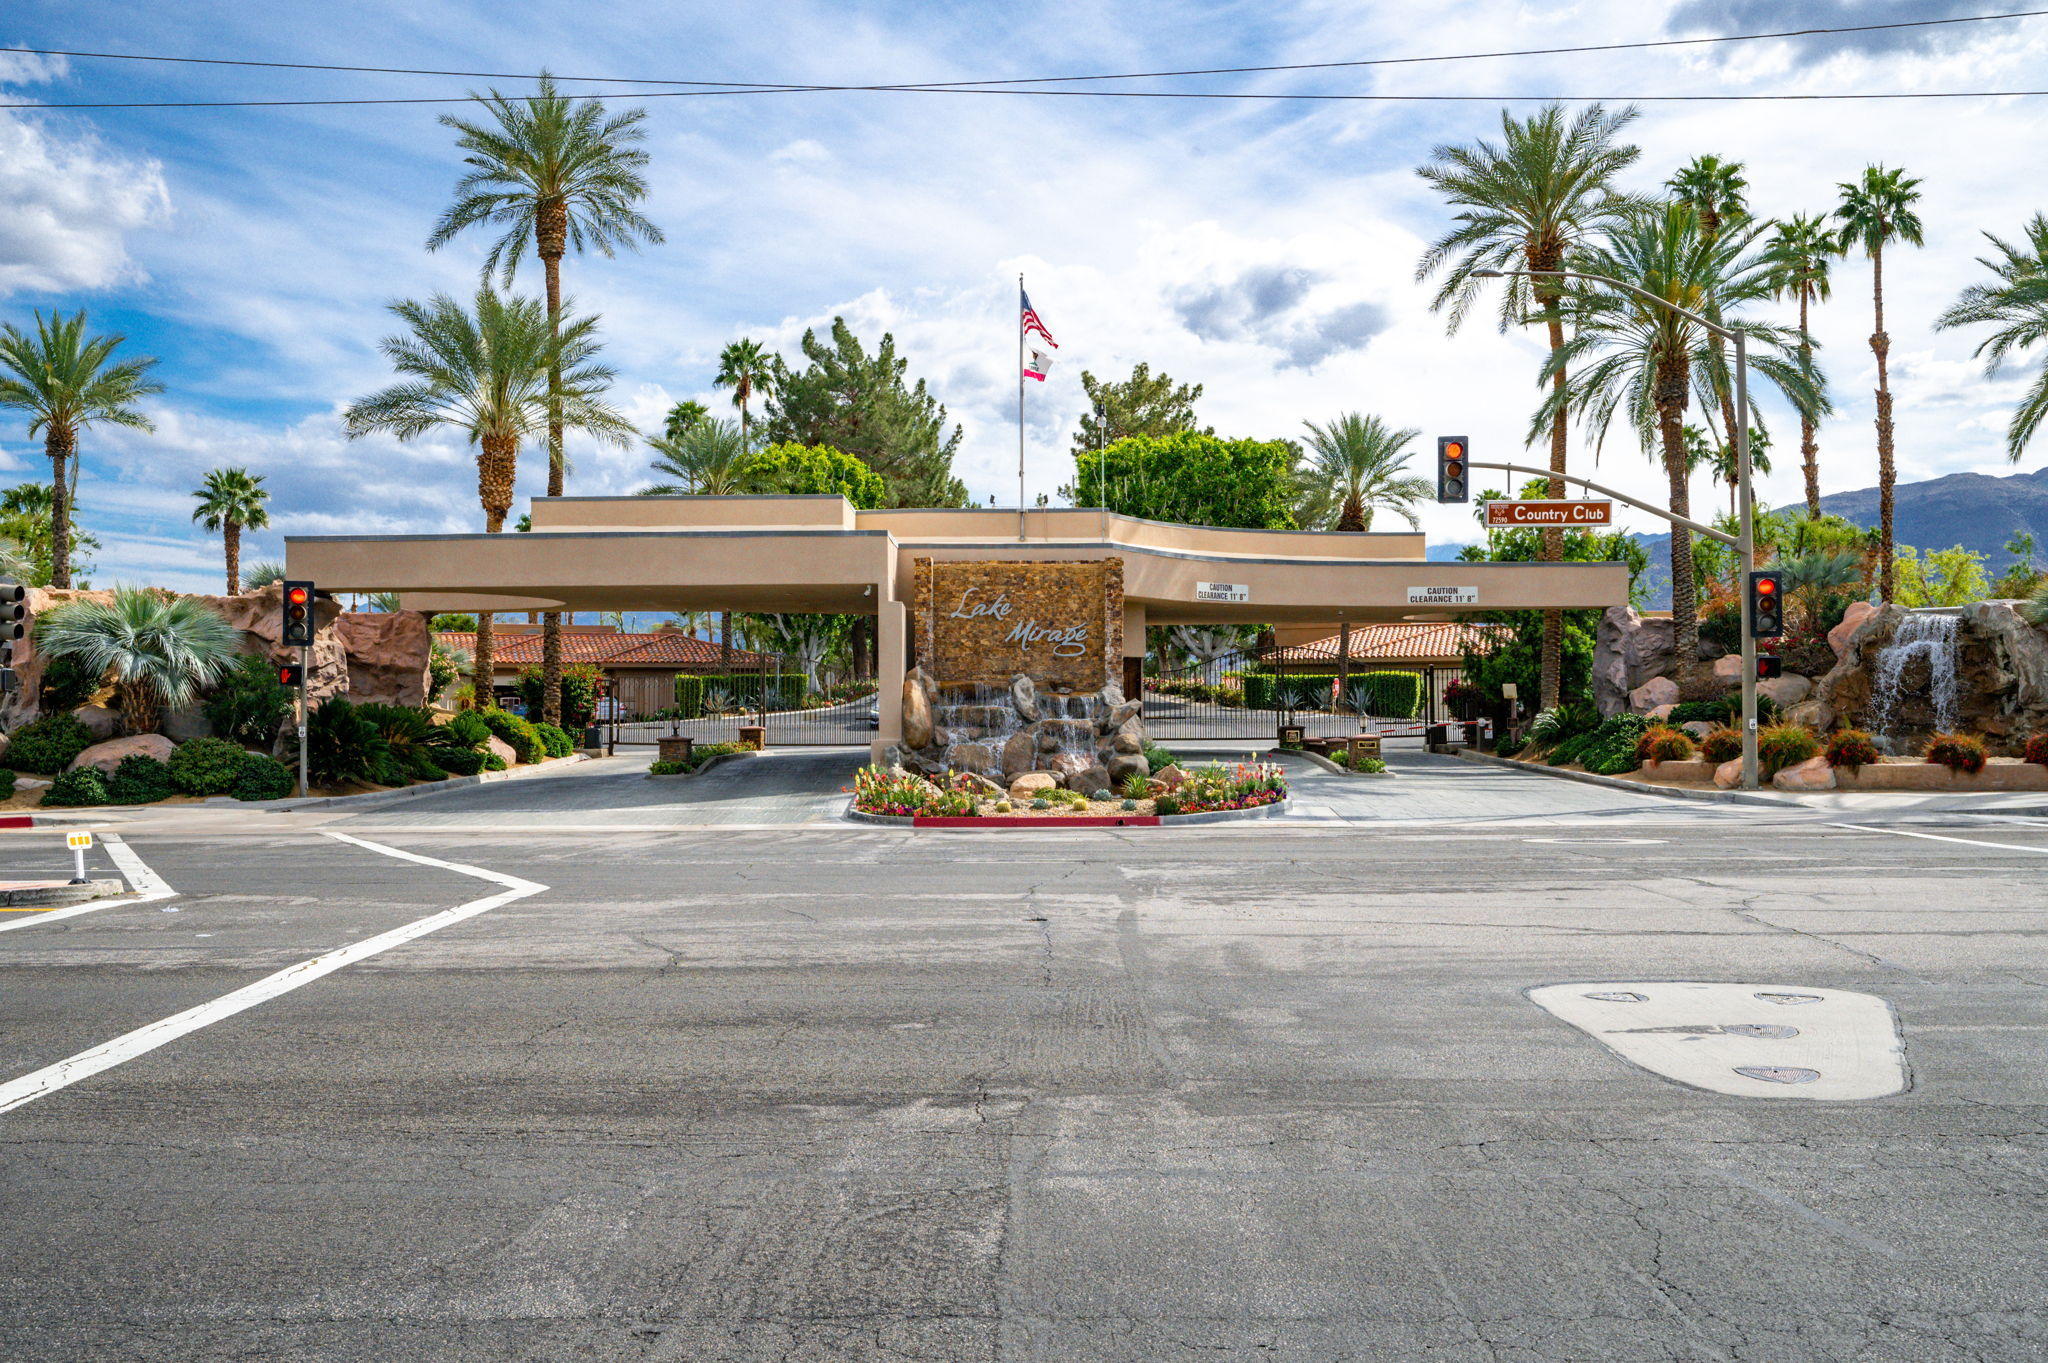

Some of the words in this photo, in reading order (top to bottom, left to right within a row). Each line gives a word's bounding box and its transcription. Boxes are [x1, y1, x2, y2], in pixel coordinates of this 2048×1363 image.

[1514, 506, 1568, 522] Country
[1573, 505, 1604, 520] Club
[951, 587, 1013, 621] Lake
[1198, 591, 1228, 600] CLEARANCE
[1410, 595, 1453, 603] CLEARANCE
[1455, 595, 1465, 603] 11'
[1005, 620, 1089, 657] Mirage
